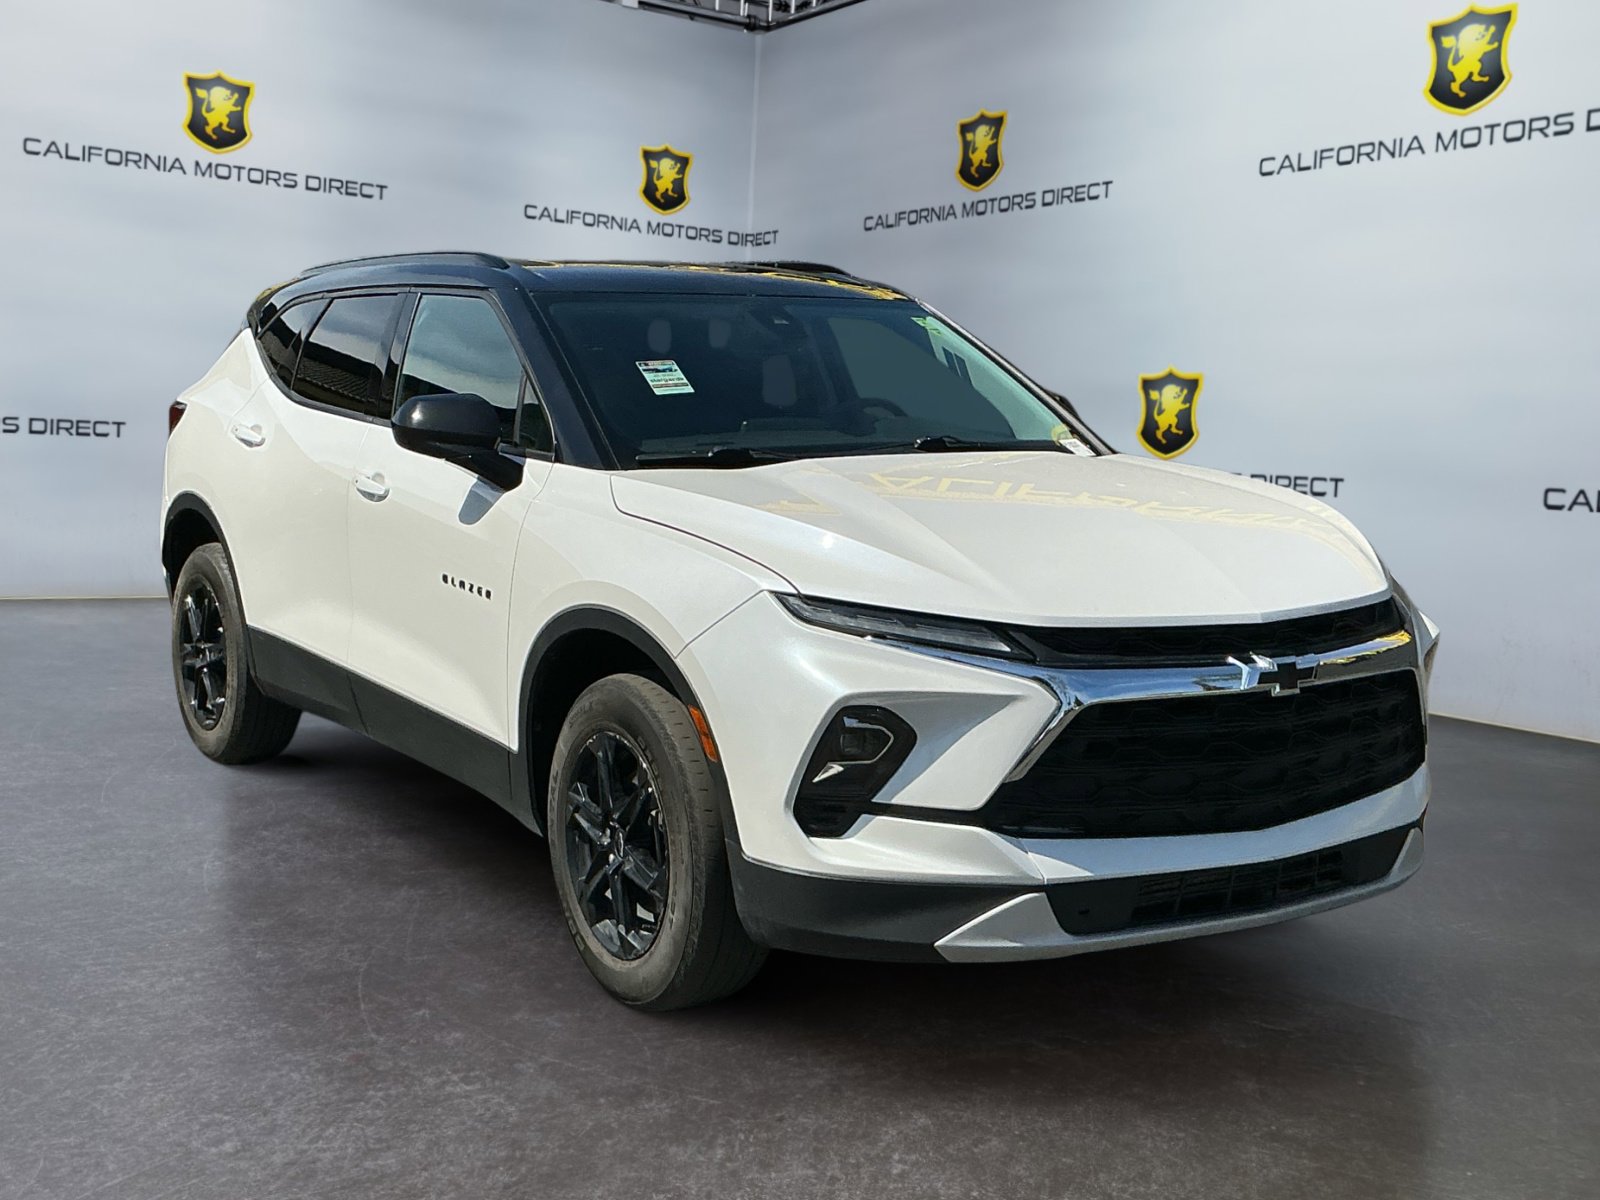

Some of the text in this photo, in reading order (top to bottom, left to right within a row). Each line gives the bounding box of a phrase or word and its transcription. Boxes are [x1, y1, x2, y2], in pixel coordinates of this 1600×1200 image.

[1259, 135, 1425, 177] CALIFORNIA
[1435, 112, 1574, 152] MOTORS
[23, 137, 388, 200] CALIFORNIA MOTORS DIRECT
[524, 204, 778, 247] CALIFORNIA MOTORS DIRECT
[864, 181, 1113, 231] CALIFORNIA MOTORS DIRECT
[29, 418, 126, 438] DIRECT
[1543, 488, 1600, 513] CA
[442, 574, 491, 600] BLAZER
